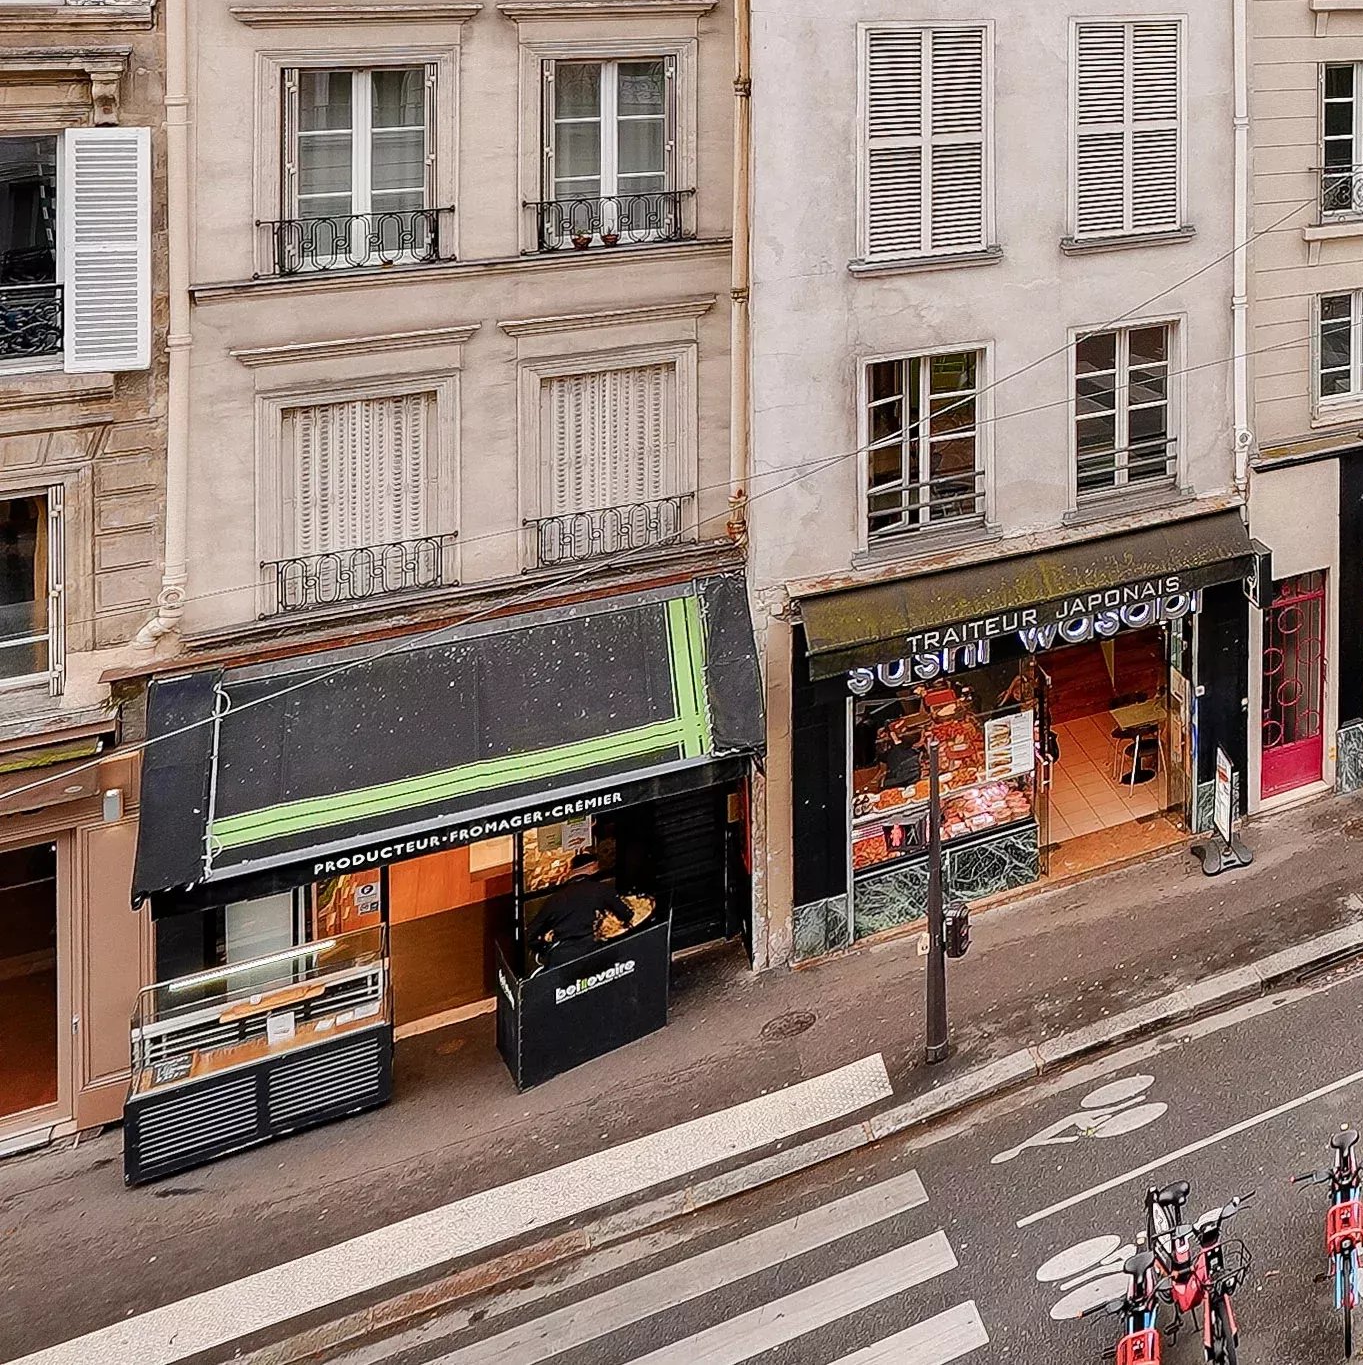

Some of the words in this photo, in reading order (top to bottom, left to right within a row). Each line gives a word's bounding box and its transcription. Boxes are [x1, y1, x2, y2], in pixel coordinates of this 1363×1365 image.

[907, 609, 1038, 653] TRAITEUR
[1055, 576, 1181, 619] JAPONAIS
[313, 836, 448, 876] PRODUCTEUR
[450, 811, 544, 843] FROMAGER
[551, 791, 623, 818] CRÉMIER
